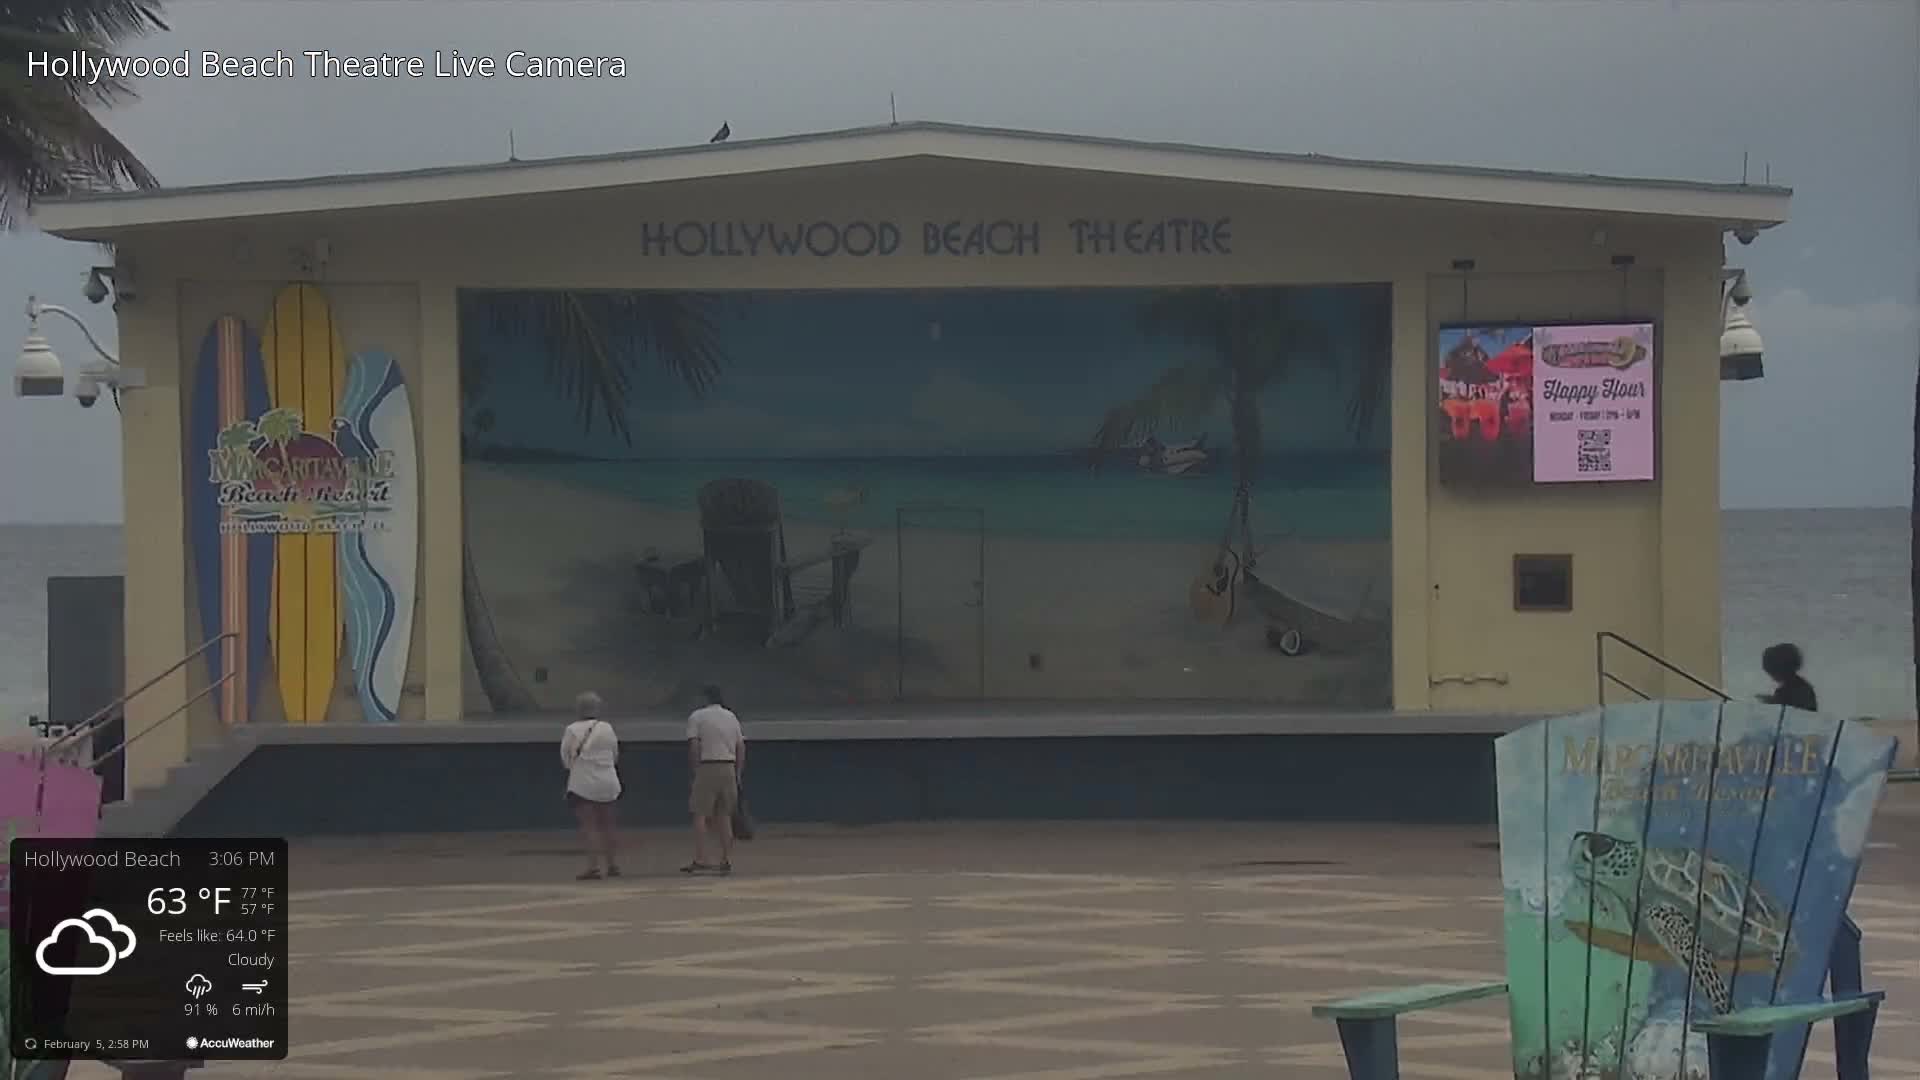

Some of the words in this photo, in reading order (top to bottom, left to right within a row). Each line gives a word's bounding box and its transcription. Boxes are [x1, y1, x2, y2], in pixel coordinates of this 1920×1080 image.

[641, 221, 900, 257] HOLLYWOOD
[922, 221, 1040, 257] BEACH
[1543, 378, 1599, 405] Happy
[1601, 377, 1645, 401] Hour
[219, 481, 298, 503] Beach
